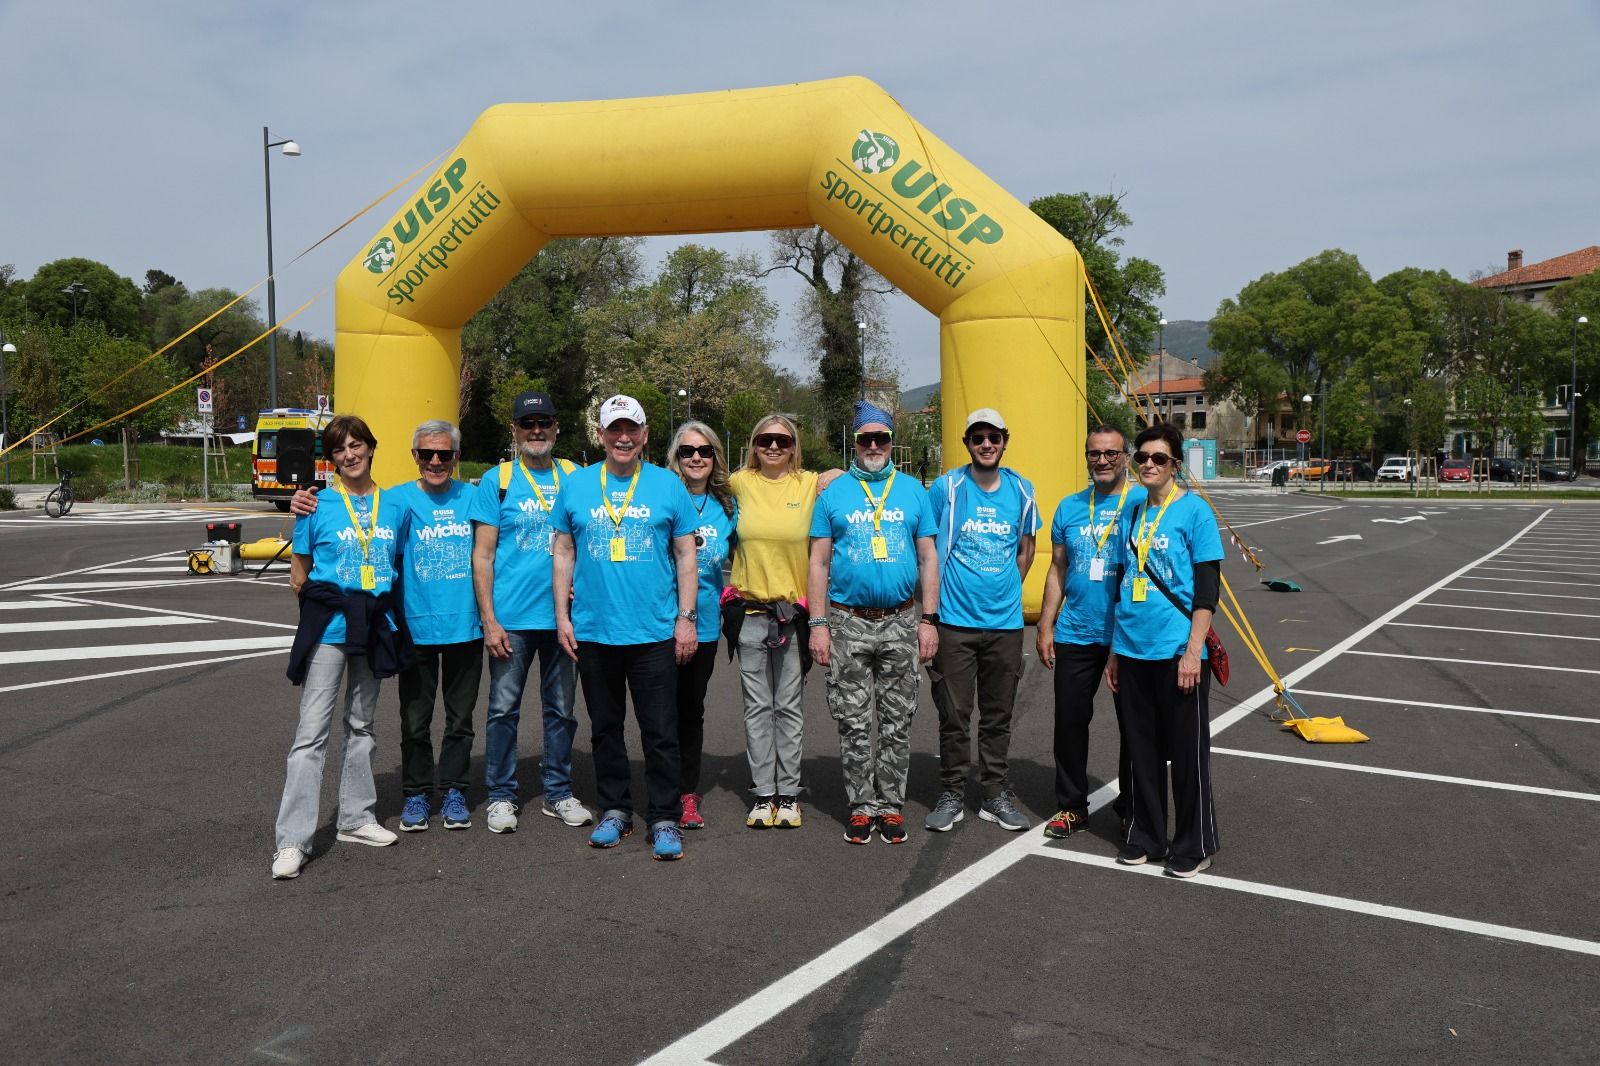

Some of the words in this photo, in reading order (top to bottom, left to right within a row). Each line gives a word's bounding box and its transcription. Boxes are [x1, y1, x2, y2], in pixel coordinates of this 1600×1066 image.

[392, 157, 467, 244] UISP
[820, 170, 972, 288] sportpertutti
[891, 160, 1004, 245] UISP
[386, 183, 501, 305] sportpertutti
[415, 521, 471, 541] vivicittà
[446, 572, 466, 580] MARSH
